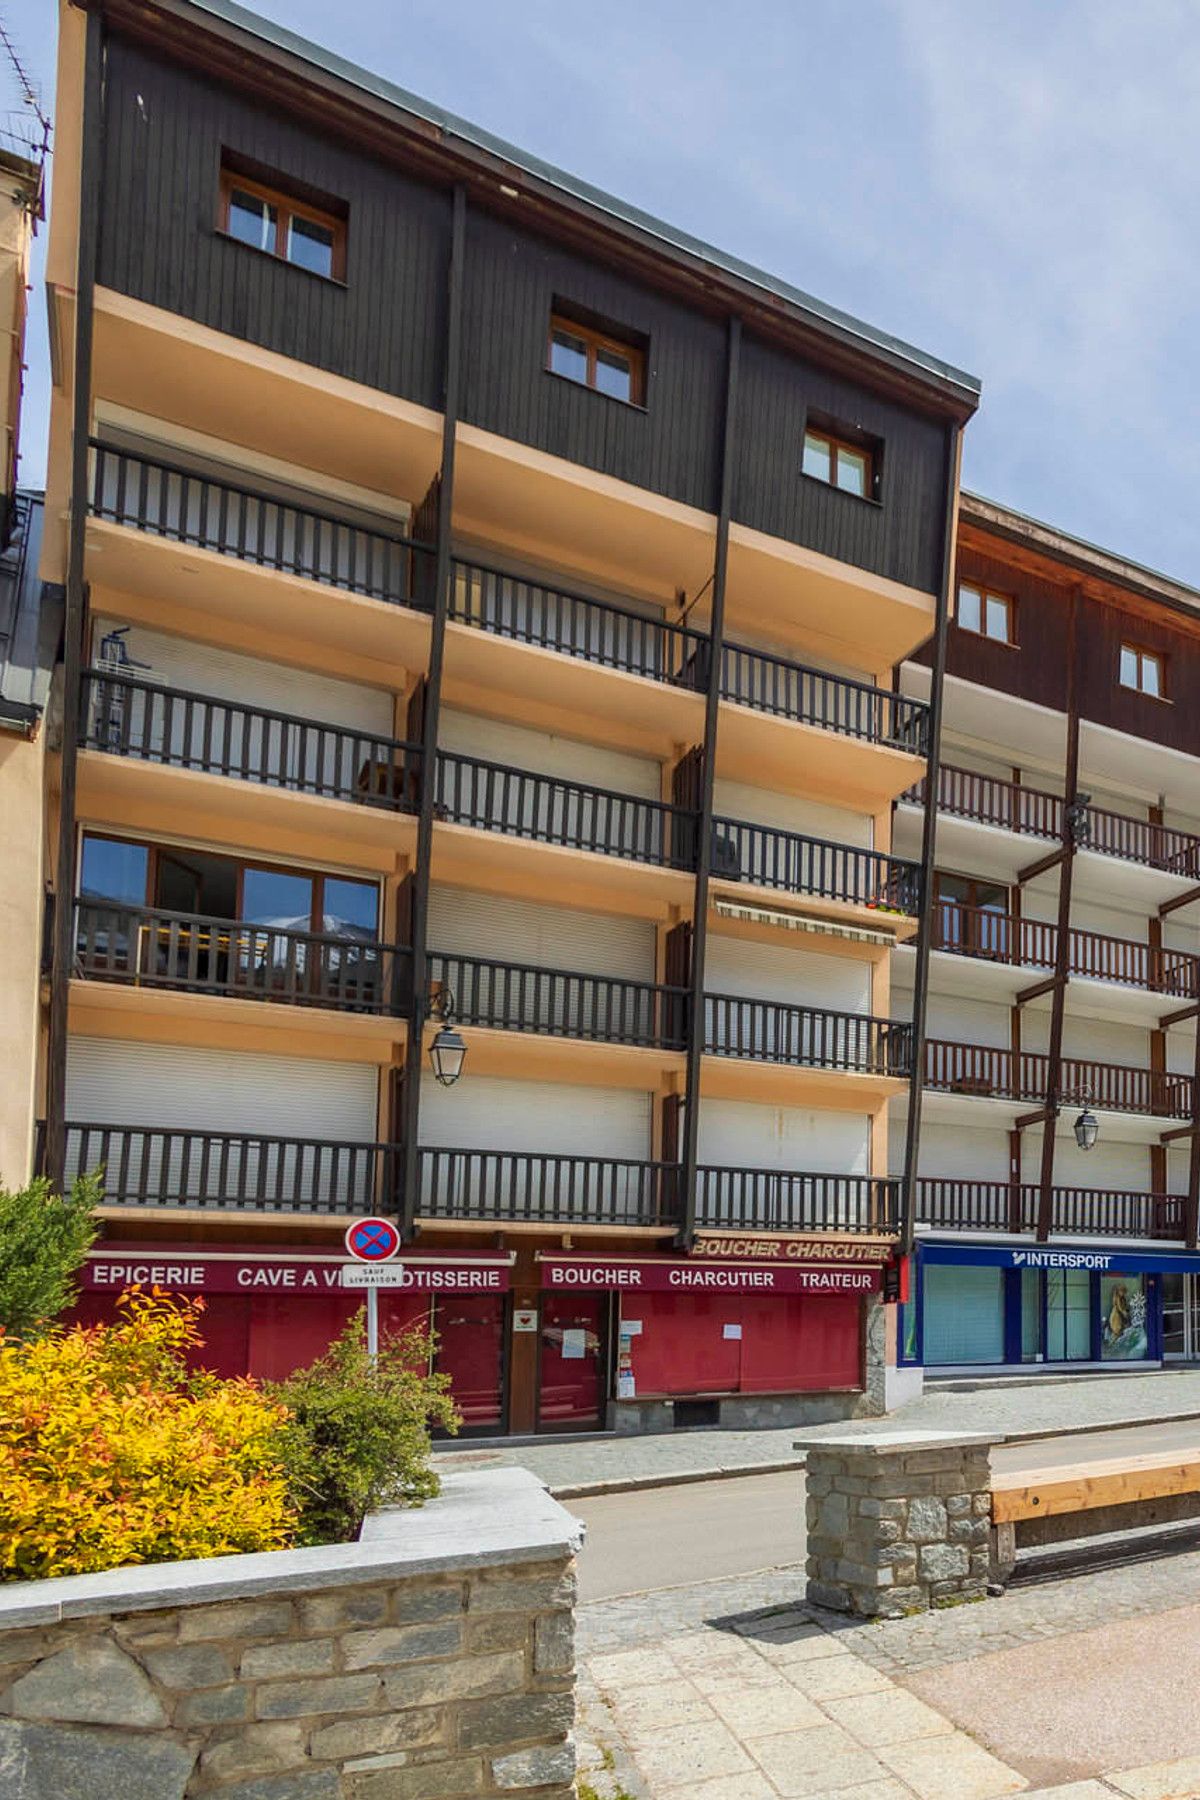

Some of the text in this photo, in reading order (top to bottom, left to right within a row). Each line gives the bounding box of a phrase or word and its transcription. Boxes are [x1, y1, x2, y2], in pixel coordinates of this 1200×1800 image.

[693, 1239, 892, 1260] BOUCHER CHARCUTIER
[1026, 1252, 1112, 1269] INTERSPORT
[93, 1265, 501, 1287] EPICERIE CAVE A VI OTISSERIE
[350, 1276, 397, 1284] LIVRAISON
[362, 1268, 384, 1276] SAUF
[551, 1268, 872, 1288] BOUCHER CHARCUTIER TRAITEUR
